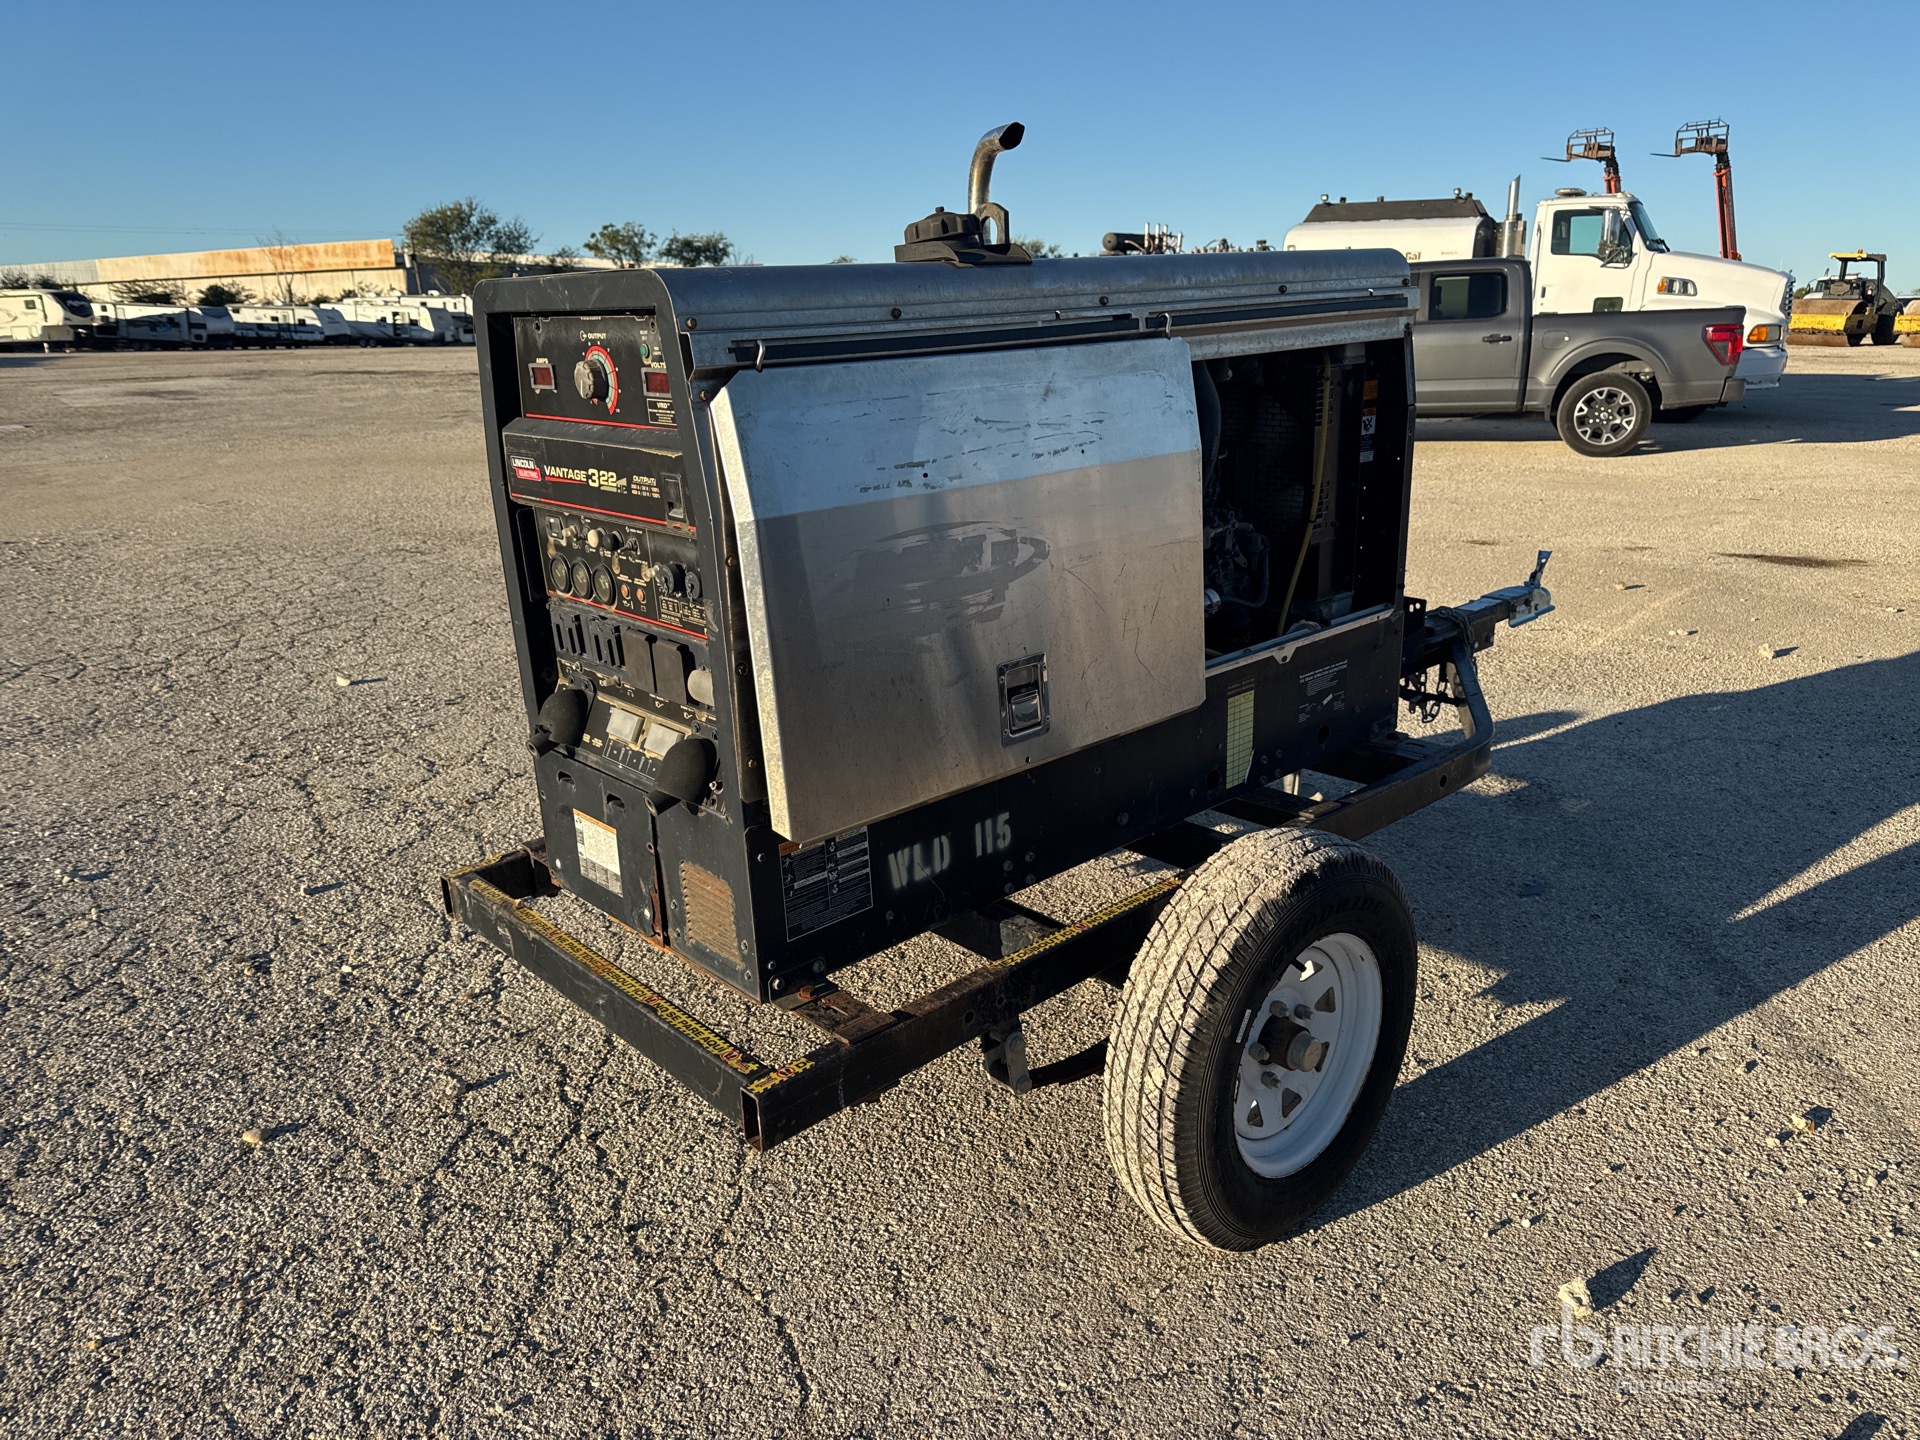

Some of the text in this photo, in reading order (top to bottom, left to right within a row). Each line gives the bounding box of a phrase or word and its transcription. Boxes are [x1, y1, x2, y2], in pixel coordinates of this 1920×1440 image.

[511, 458, 535, 470] LINCOLN
[543, 464, 617, 488] VANTAGE 322
[632, 474, 655, 484] OUTPUT
[887, 834, 952, 890] WLD
[974, 811, 1012, 858] 115
[601, 966, 635, 991] DEBOUT
[654, 1001, 668, 1014] NO
[665, 1009, 681, 1023] SE
[676, 1016, 704, 1037] PARE
